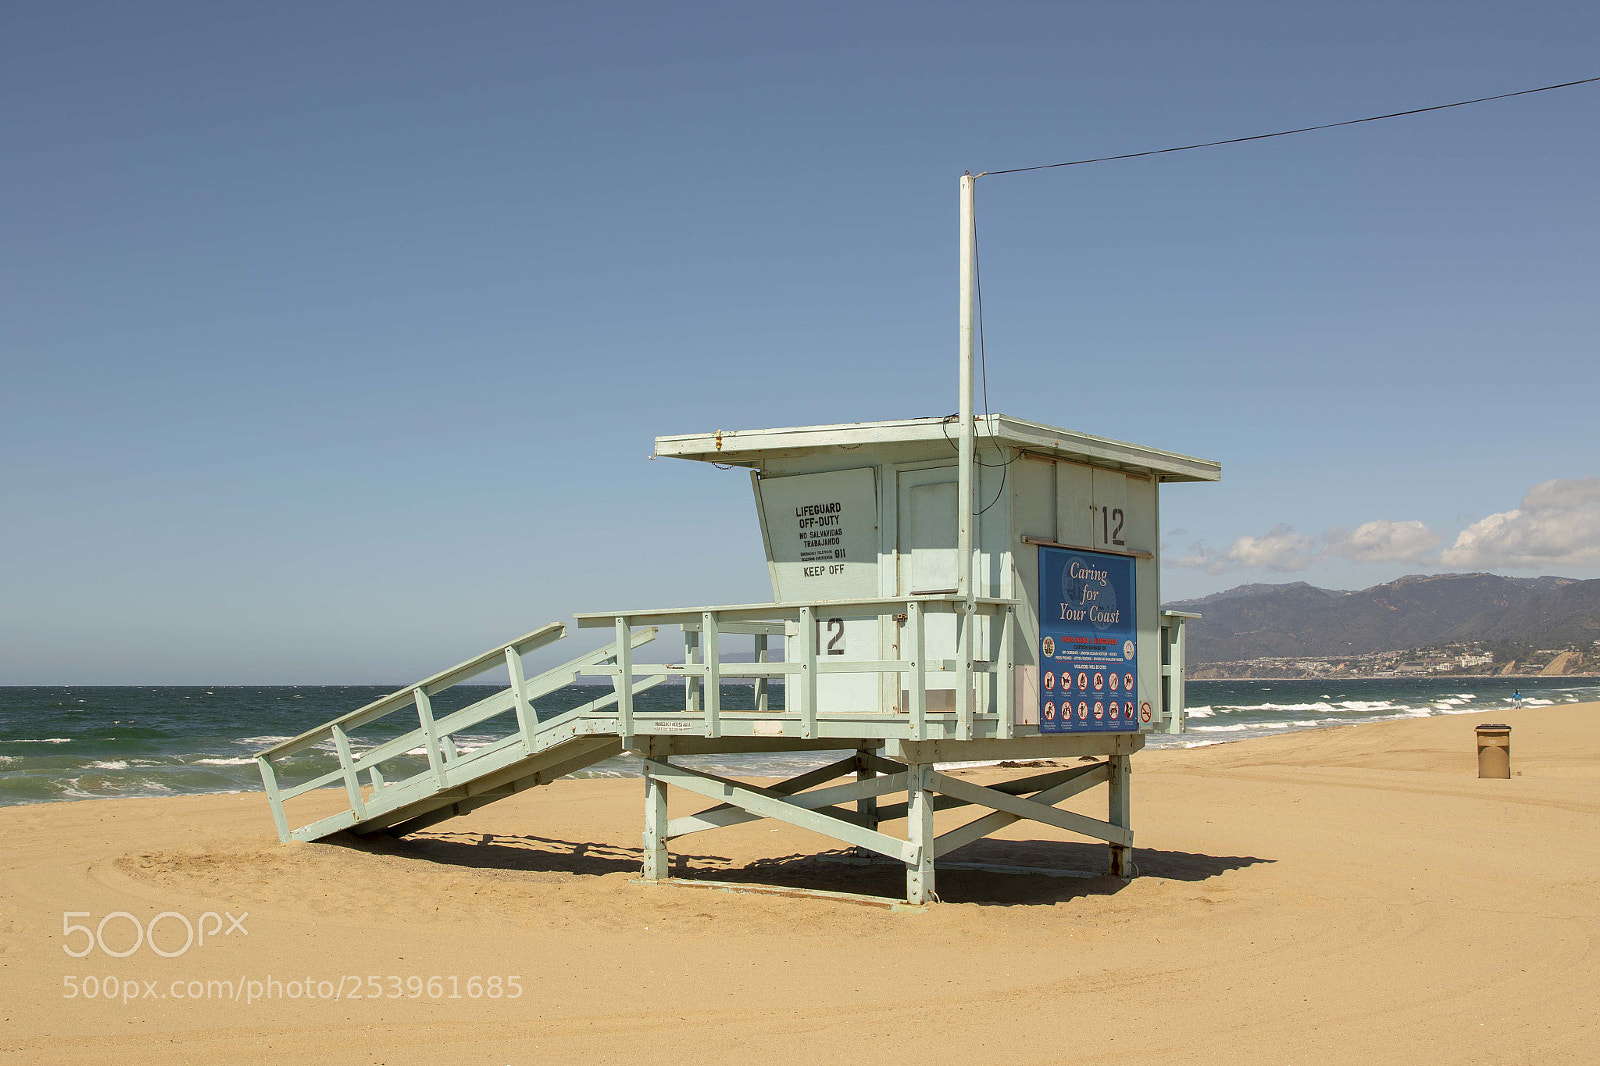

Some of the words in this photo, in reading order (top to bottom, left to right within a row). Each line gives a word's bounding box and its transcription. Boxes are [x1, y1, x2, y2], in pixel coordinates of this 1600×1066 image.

[795, 502, 841, 517] LIFEGUARD
[799, 515, 840, 529] OFF-DUTY
[1102, 506, 1124, 546] 12
[799, 532, 808, 540] NO
[809, 528, 843, 539] SALVAVIDAS
[803, 537, 840, 548] TRABAJANDO
[834, 548, 846, 559] 911
[803, 566, 825, 577] KEEP
[829, 564, 845, 575] OFF
[1070, 561, 1107, 587] Caring
[1080, 584, 1099, 605] for
[1060, 603, 1086, 621] Your
[1089, 605, 1120, 624] Coast
